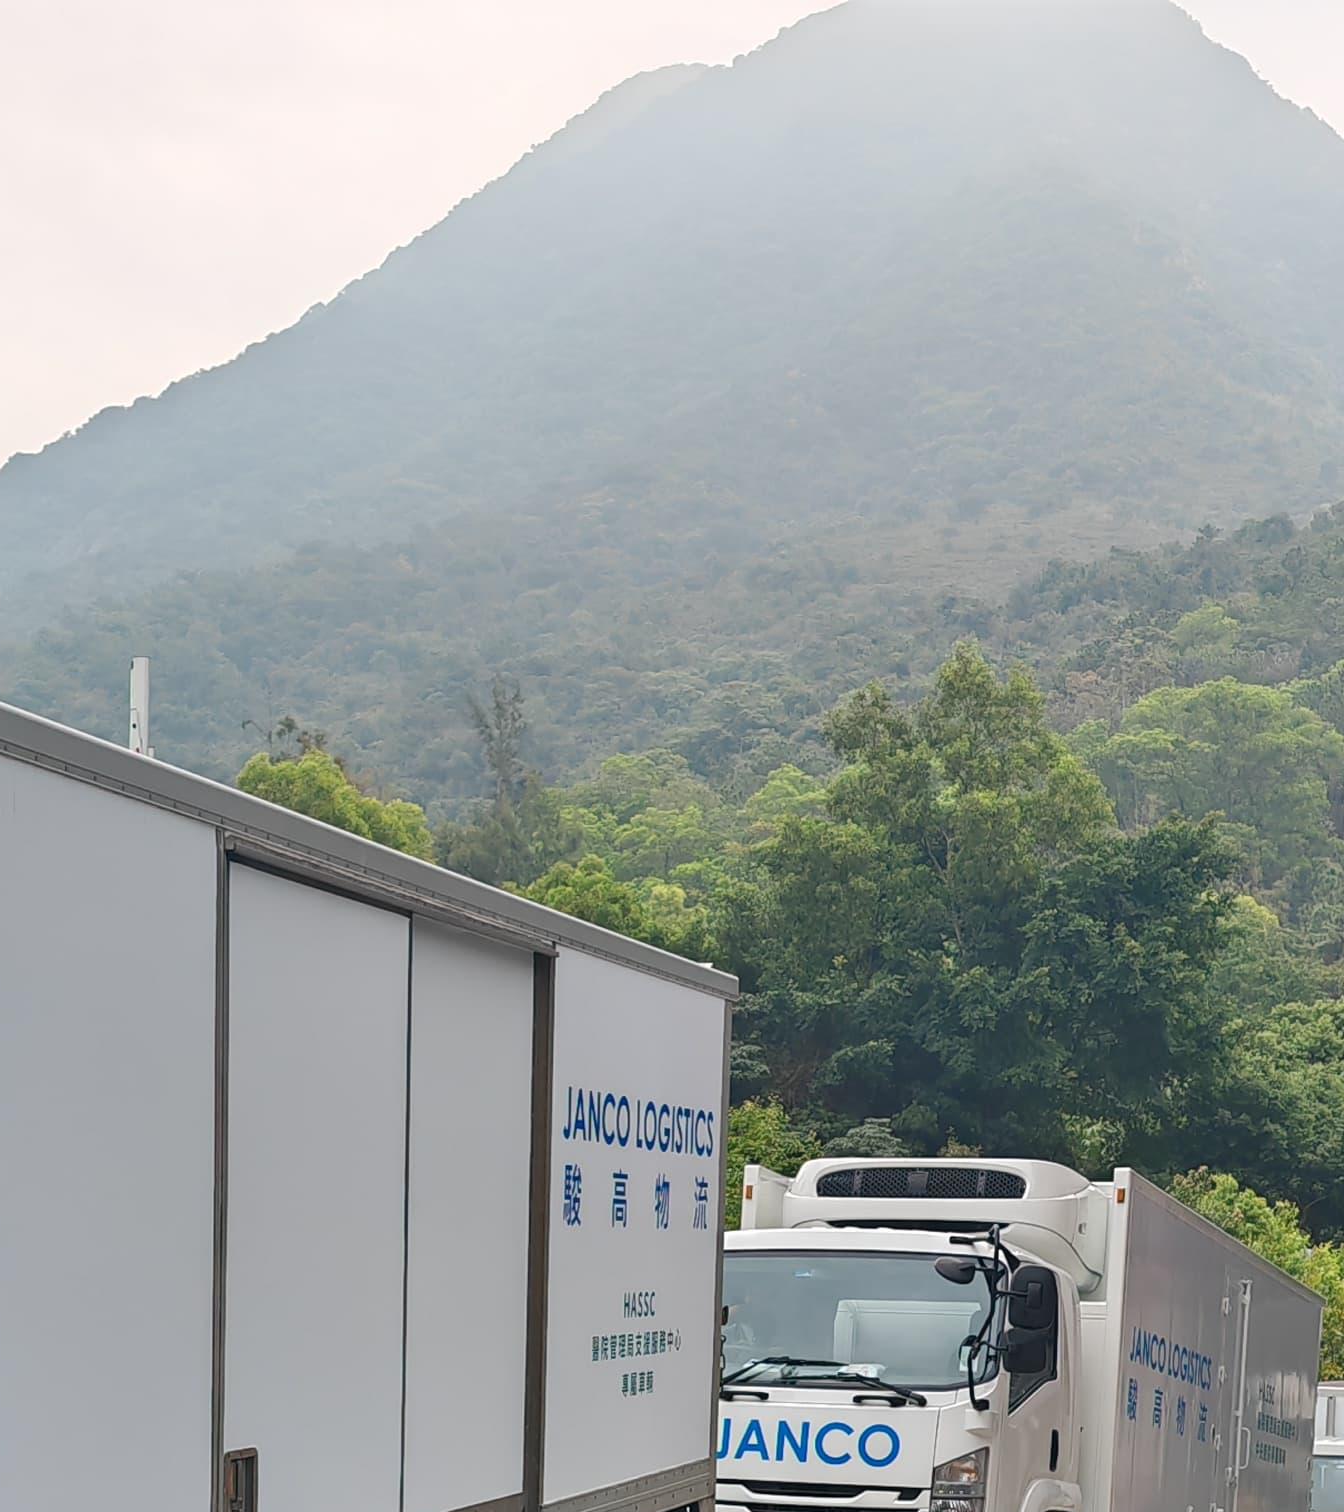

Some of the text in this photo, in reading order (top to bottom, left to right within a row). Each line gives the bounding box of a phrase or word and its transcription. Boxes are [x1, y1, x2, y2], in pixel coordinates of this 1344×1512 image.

[564, 1086, 714, 1157] JANCO LOGISTICS
[563, 1164, 708, 1229] 駿高物流
[624, 1292, 656, 1318] HASSC
[1130, 1326, 1212, 1391] JANCO LOGISTICS
[716, 1418, 900, 1468] JANCO
